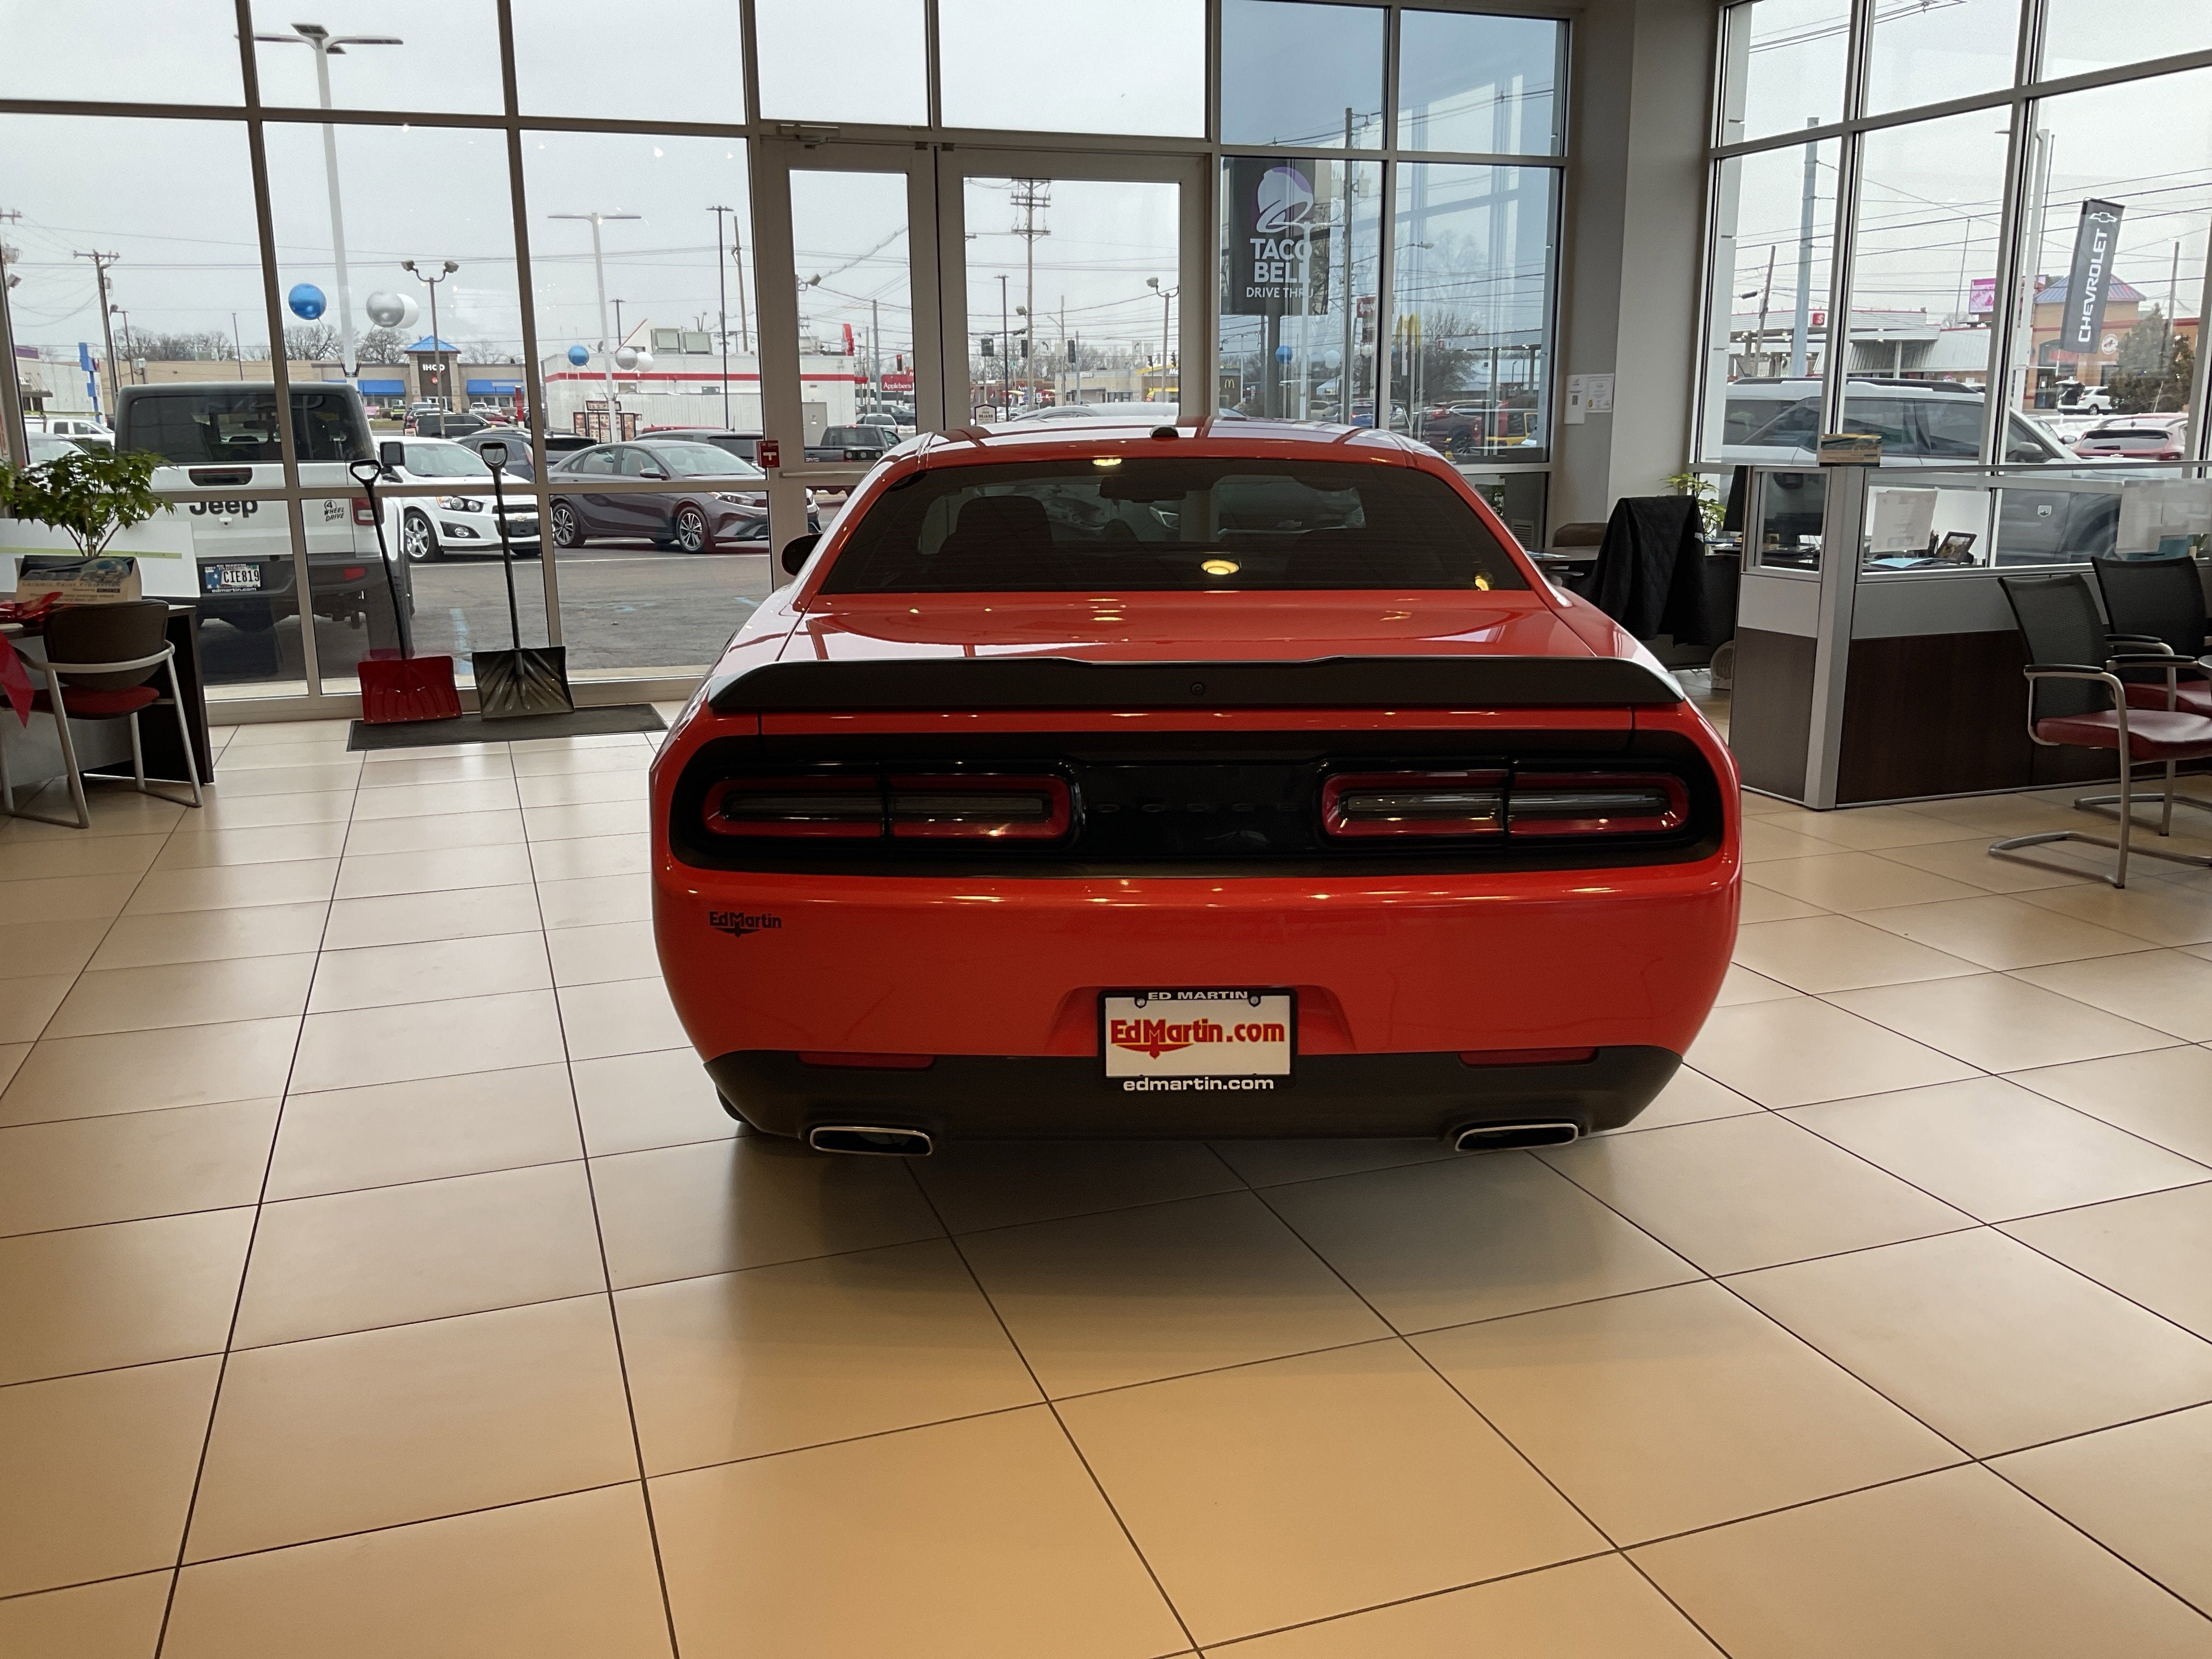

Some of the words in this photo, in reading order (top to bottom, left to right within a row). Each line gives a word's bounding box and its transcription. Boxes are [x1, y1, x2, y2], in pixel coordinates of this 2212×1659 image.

[1250, 238, 1313, 261] TACO
[1254, 262, 1311, 283] BELL
[1246, 287, 1280, 298] DRIVE
[2078, 228, 2108, 342] CHEVROLET
[189, 500, 258, 518] Jeep
[324, 507, 345, 516] WHEEL
[326, 513, 345, 522] DRIVE
[223, 570, 259, 583] CIE819
[1148, 992, 1172, 1000] ED
[1178, 991, 1248, 1000] MARTIN
[1110, 1018, 1285, 1044] EdMartin.com
[1123, 1076, 1274, 1091] edmartin.com
